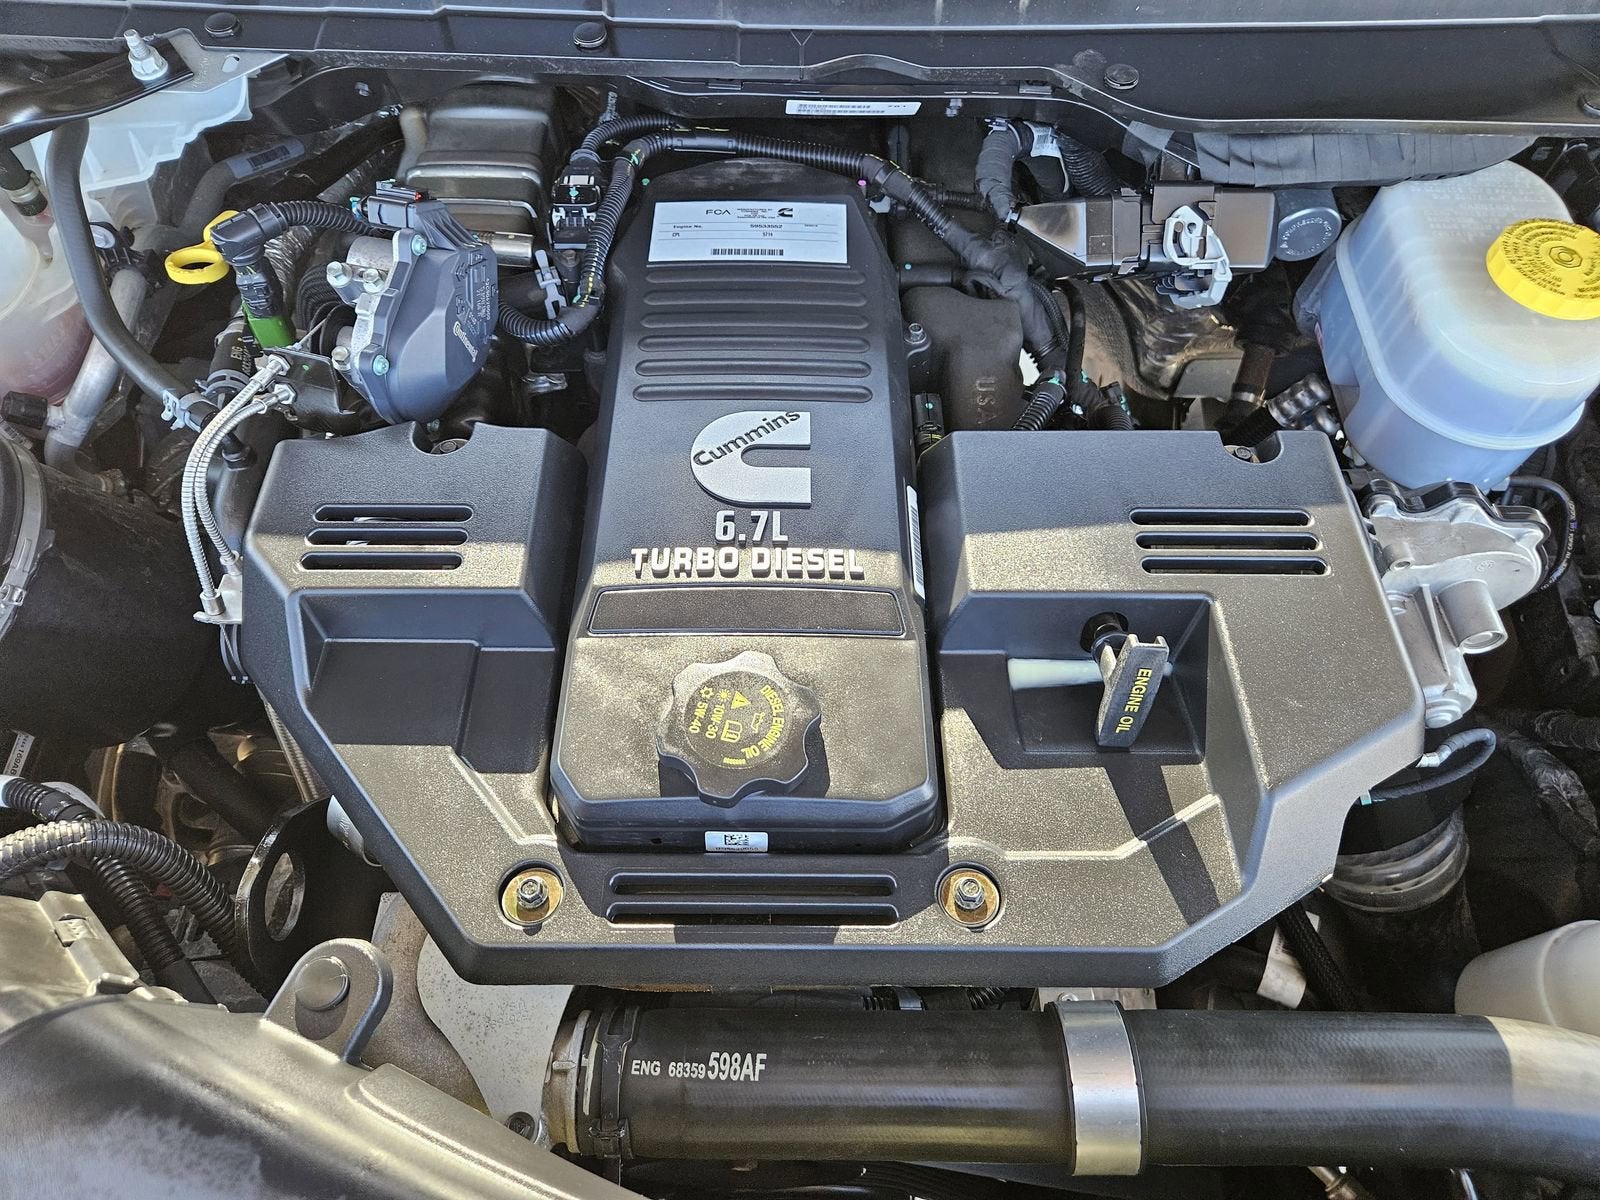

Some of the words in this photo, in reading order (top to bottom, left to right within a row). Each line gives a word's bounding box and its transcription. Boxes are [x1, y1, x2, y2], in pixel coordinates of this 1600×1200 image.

[692, 410, 801, 467] Cummins
[715, 509, 789, 544] 6.7L
[631, 546, 739, 579] TURBO
[750, 547, 866, 580] DIESEL
[760, 684, 785, 716] DIESEL
[1124, 668, 1153, 713] ENGINE
[688, 701, 708, 734] 5W-40
[705, 704, 726, 739] 10W-30
[758, 717, 785, 751] ENGINE
[1115, 716, 1134, 734] OIL
[740, 745, 760, 759] OIL
[631, 1059, 661, 1076] ENG
[668, 1061, 706, 1079] 68359
[707, 1051, 767, 1081] 598AF
